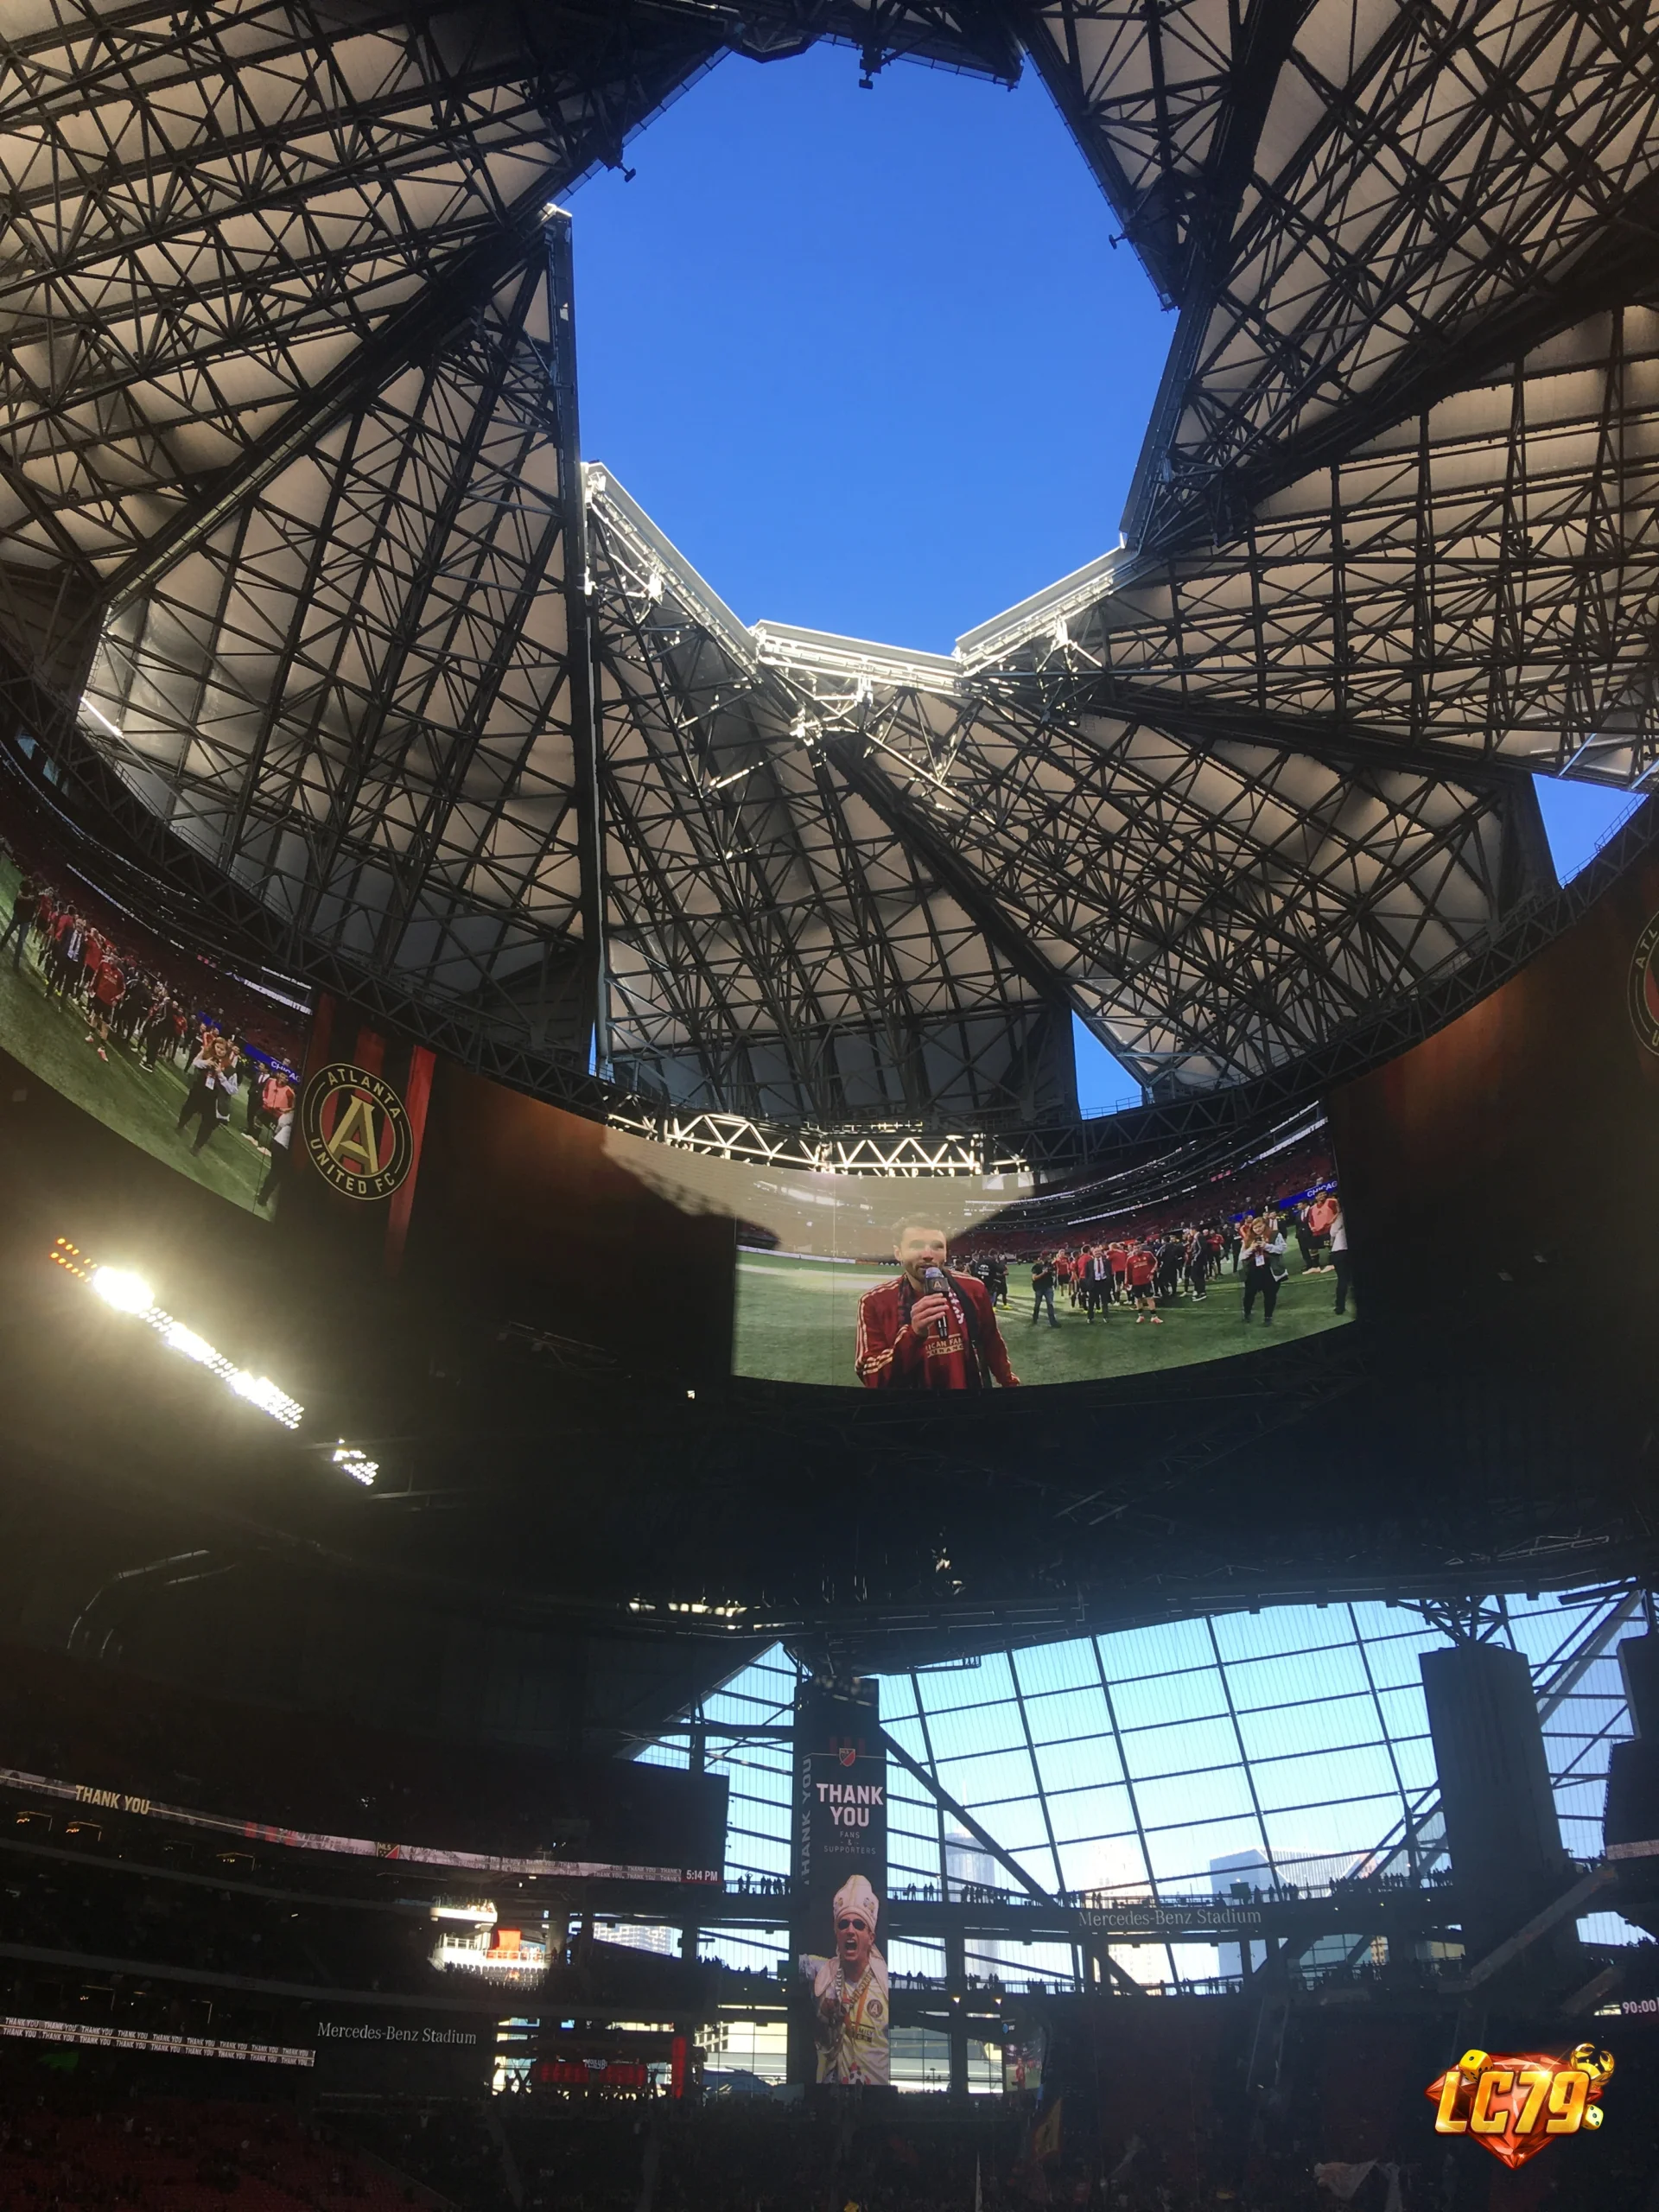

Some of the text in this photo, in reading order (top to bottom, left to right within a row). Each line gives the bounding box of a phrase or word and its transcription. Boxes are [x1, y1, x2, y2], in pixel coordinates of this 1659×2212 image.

[327, 1068, 401, 1118] ATLANTA
[310, 1138, 395, 1194] UNITED FC
[76, 1784, 150, 1815] THANK YOU
[816, 1783, 884, 1806] THANK
[830, 1806, 870, 1827] YOU
[823, 1845, 876, 1855] SUPPORTERS
[687, 1870, 718, 1881] 5:14 PM
[1079, 1908, 1262, 1927] Mercedes-Benz Stadium
[1622, 1999, 1657, 2014] 90:00
[6, 2017, 25, 2026] THANK
[44, 2021, 63, 2030] THANK
[81, 2025, 101, 2034] THANK
[118, 2030, 136, 2038] THANK
[153, 2033, 171, 2042] THANK
[317, 2022, 477, 2045] Mercedes-Benz Stadium
[3, 2028, 23, 2037] THANK
[42, 2031, 61, 2040] THANK
[79, 2036, 99, 2044] THANK
[185, 2047, 203, 2056] THANK
[218, 2050, 235, 2059] THANK
